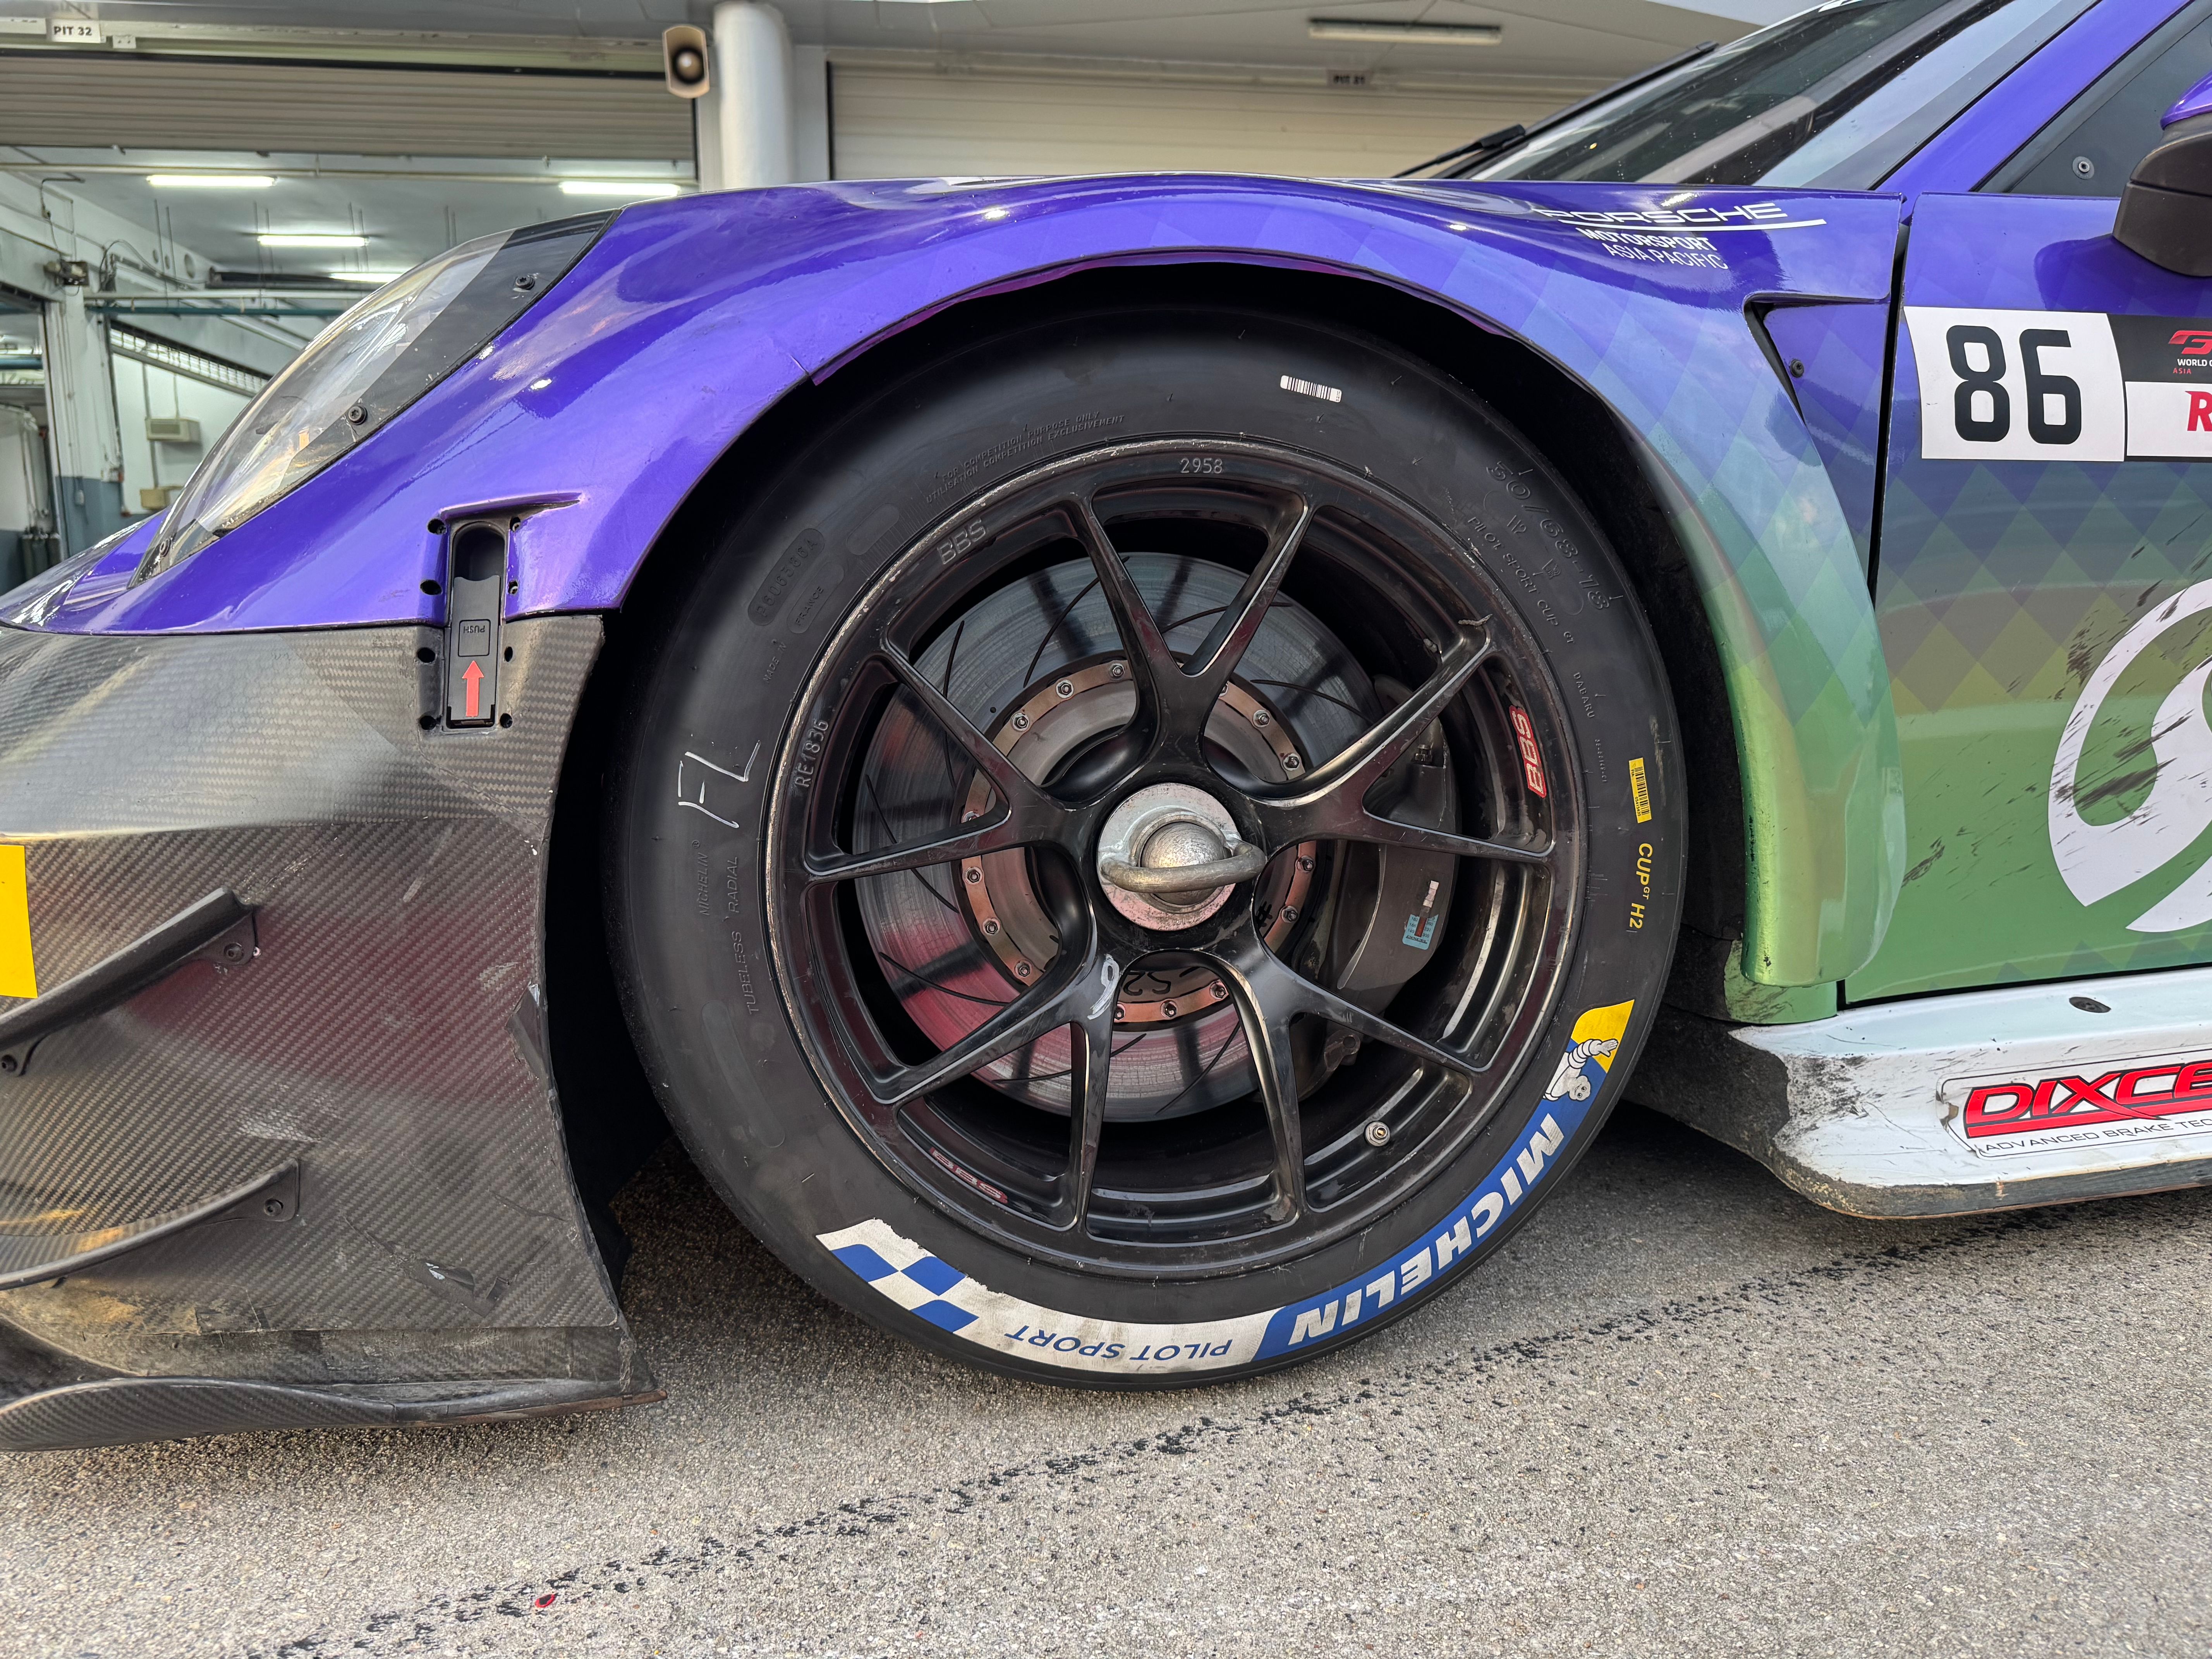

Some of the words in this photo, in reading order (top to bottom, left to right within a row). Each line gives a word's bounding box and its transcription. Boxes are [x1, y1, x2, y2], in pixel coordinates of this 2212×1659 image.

[54, 26, 74, 35] PIT
[78, 26, 92, 36] 32
[1532, 203, 1788, 223] PORSCHE
[1575, 227, 1718, 251] MOTORSPORT
[1602, 242, 1655, 262] ASIA
[1653, 249, 1728, 270] PACIFIC
[1946, 325, 2081, 445] 86
[926, 465, 977, 503] UTILISATION
[984, 436, 1042, 468] COMPETITION
[1048, 416, 1125, 440] EXCLUSIVEMENT
[942, 467, 958, 482] FOR
[964, 434, 1022, 468] COMPETITION
[1028, 419, 1070, 438] PURPOSE
[1076, 411, 1099, 422] ONLY
[1180, 458, 1222, 474] 2958
[937, 518, 986, 565] BBS
[1468, 517, 1501, 550] PILOT
[1503, 553, 1537, 592] SPORT
[1537, 600, 1558, 625] CUP
[795, 586, 824, 625] FRANCE
[464, 625, 485, 633] PUSH
[763, 656, 779, 684] MADE
[1573, 672, 1595, 718] DABARU
[795, 719, 828, 787] RE1836
[1510, 709, 1544, 795] BBS
[697, 852, 709, 916] MICHELIN
[727, 856, 739, 914] RADIAL
[1630, 903, 1645, 929] H2
[732, 931, 759, 1015] TUBELESS
[1985, 1132, 2100, 1151] ADVANCED
[2102, 1123, 2174, 1137] BRAKE
[932, 1149, 1003, 1199] BBS
[1288, 1113, 1565, 1346] MICHELIN
[1004, 1325, 1126, 1358] SPORT
[1129, 1339, 1233, 1360] PILOT
